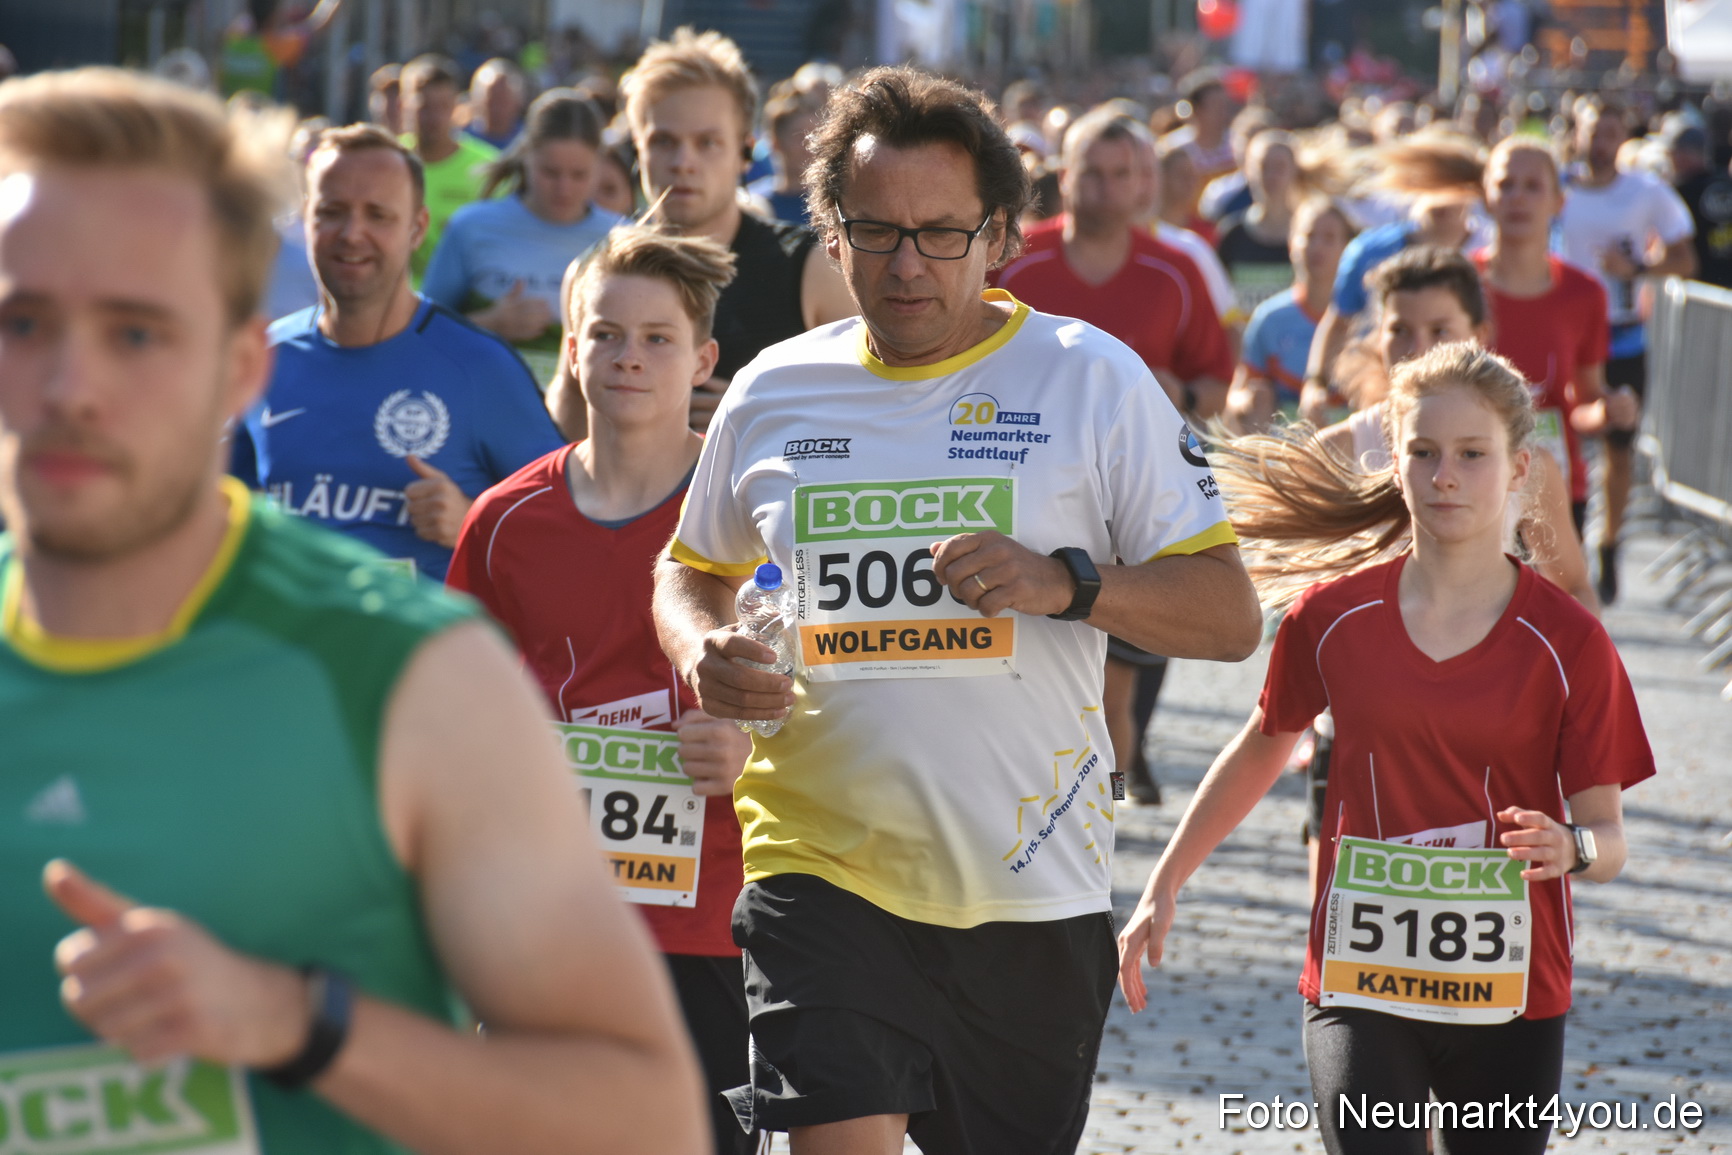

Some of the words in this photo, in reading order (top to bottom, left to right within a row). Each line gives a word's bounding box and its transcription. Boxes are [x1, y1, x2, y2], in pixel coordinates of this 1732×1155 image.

[954, 402, 995, 425] 20
[999, 413, 1037, 423] JAHRE
[784, 438, 852, 456] BOCK
[950, 429, 1051, 444] Neumarkter
[948, 447, 1030, 464] Stadtlauf
[809, 486, 996, 535] BOCK
[817, 548, 967, 612] 506
[815, 626, 993, 656] WOLFGANG
[562, 732, 690, 779] OCK
[1009, 840, 1041, 874] 14./15.
[1038, 780, 1080, 840] September
[1077, 753, 1099, 782] 2019
[608, 858, 676, 883] TIAN
[1349, 847, 1510, 893] BOCK
[1349, 902, 1505, 962] 5183
[1513, 915, 1522, 926] S
[1356, 971, 1493, 1002] KATHRIN
